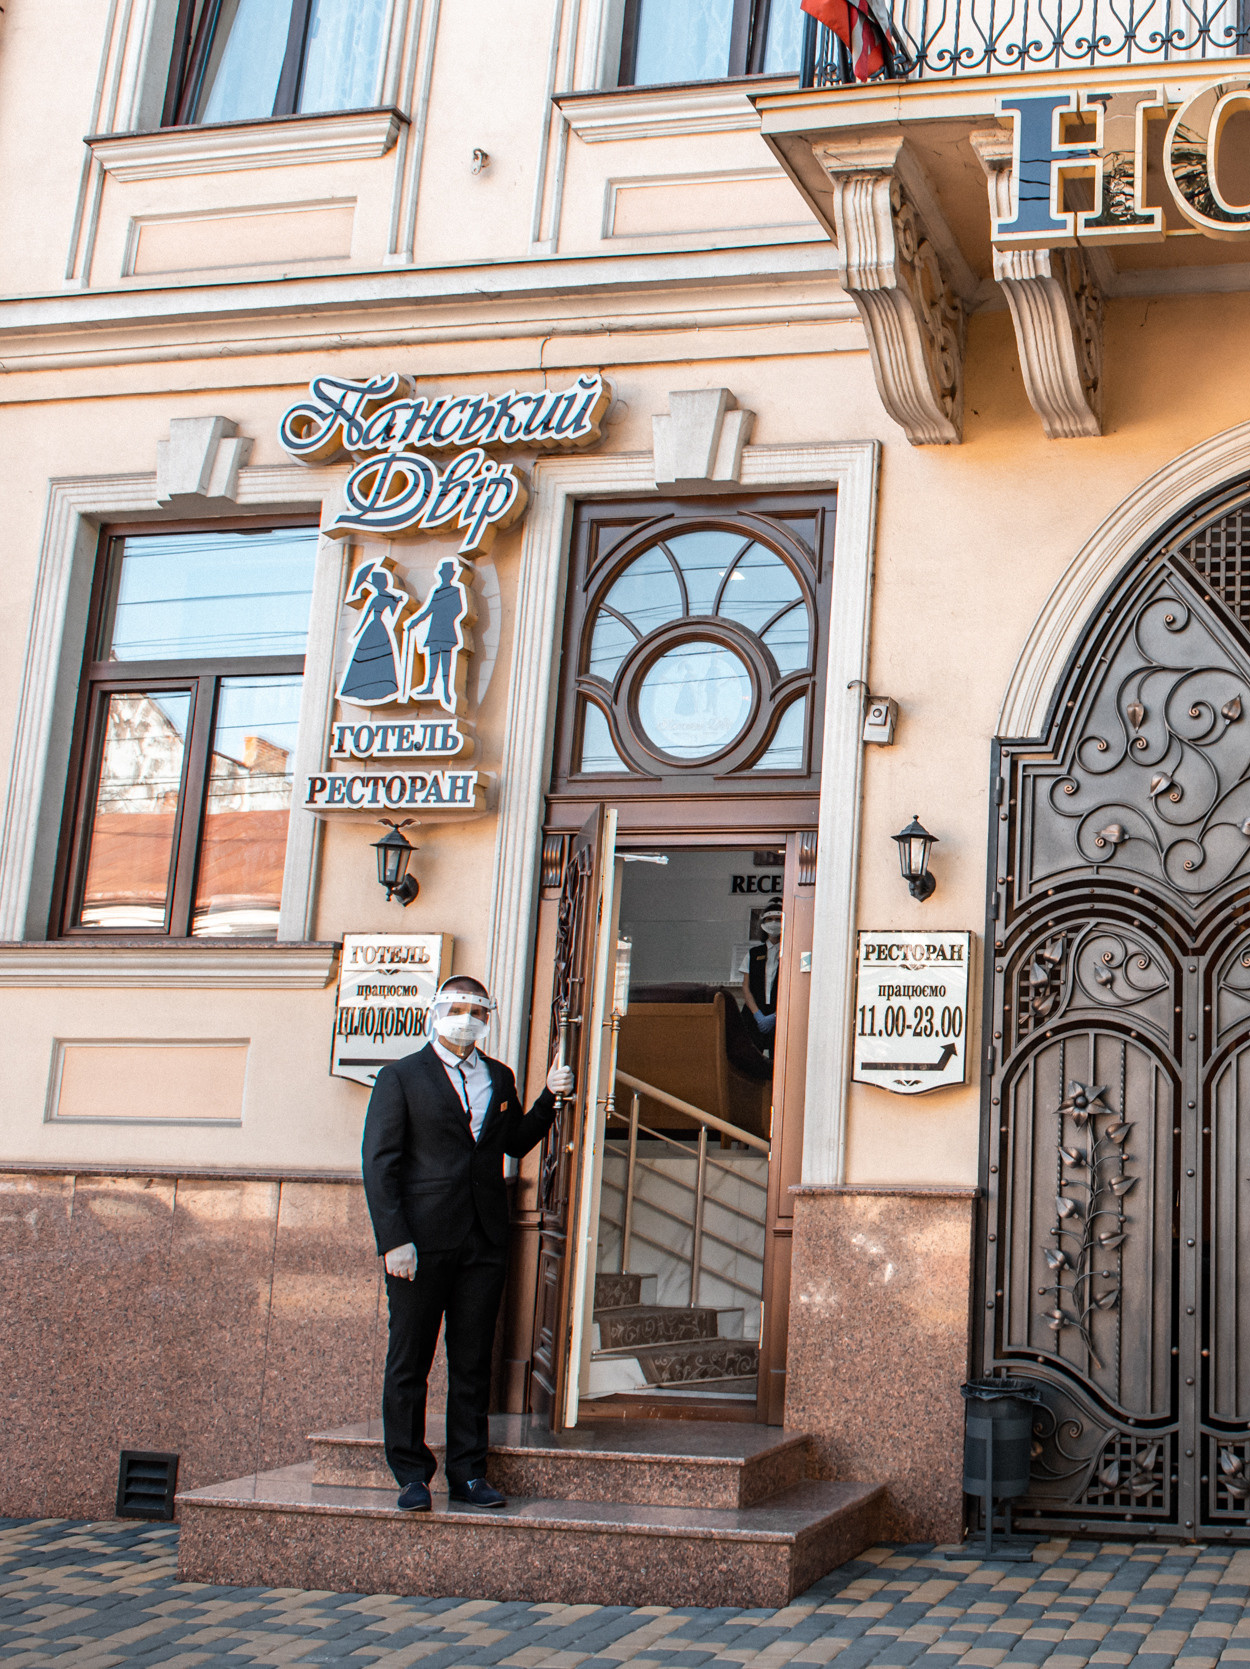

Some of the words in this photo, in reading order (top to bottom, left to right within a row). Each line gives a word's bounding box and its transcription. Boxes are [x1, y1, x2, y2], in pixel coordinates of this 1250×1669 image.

[280, 374, 602, 450] Панський
[331, 448, 517, 550] Двір
[333, 722, 460, 753] ГОТЕЛЬ
[306, 773, 474, 804] РЕСТОРАН
[731, 875, 783, 893] RECE
[350, 945, 431, 965] ГОТЕЛЬ
[863, 943, 964, 962] РЕСТОРАН
[356, 984, 418, 1000] працюємо
[878, 984, 946, 1001] працюємо
[858, 1004, 963, 1038] 11.00-23.00
